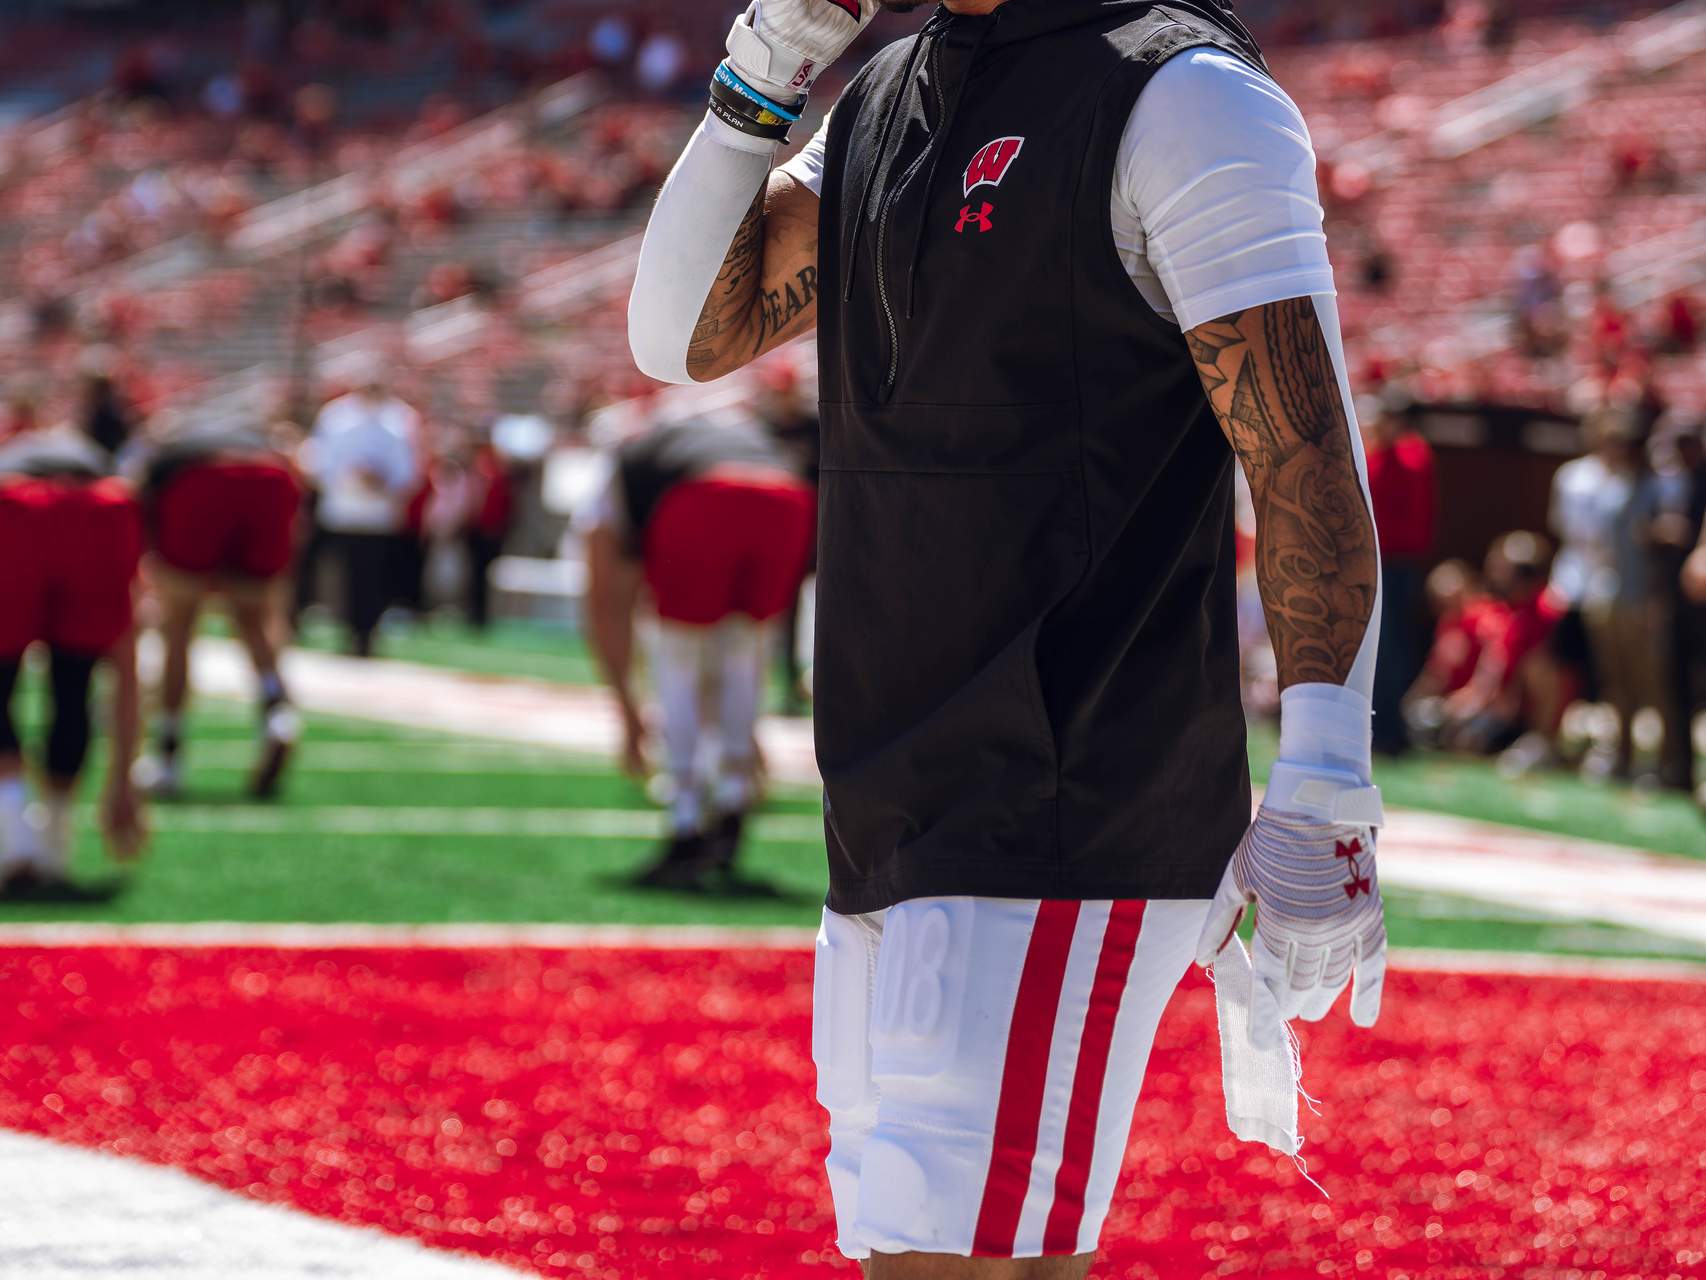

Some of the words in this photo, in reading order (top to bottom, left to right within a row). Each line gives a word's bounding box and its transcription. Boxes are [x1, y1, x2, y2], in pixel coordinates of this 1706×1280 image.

[790, 63, 814, 87] UA
[722, 111, 744, 128] PLAN
[963, 136, 1025, 198] W
